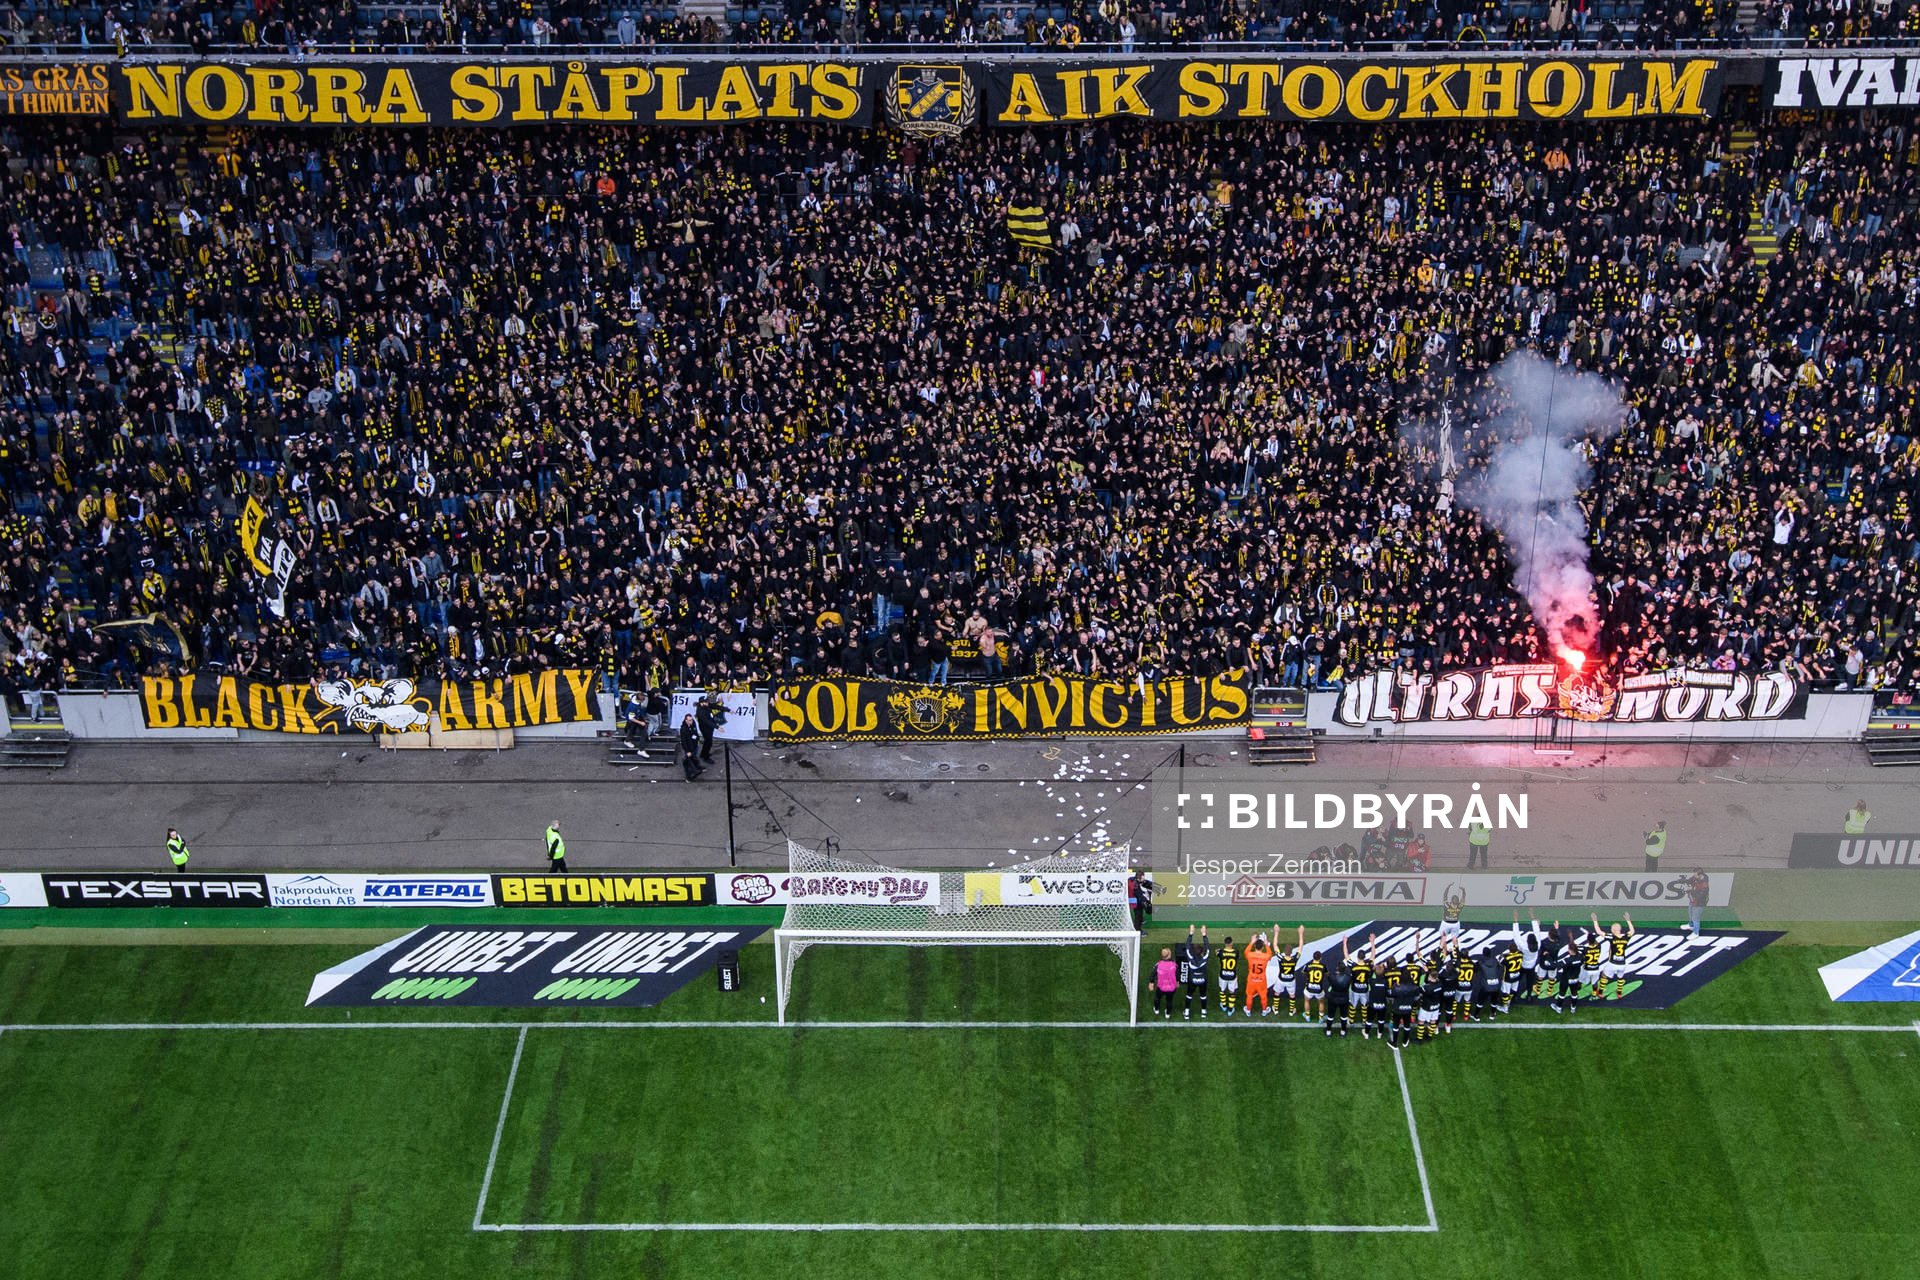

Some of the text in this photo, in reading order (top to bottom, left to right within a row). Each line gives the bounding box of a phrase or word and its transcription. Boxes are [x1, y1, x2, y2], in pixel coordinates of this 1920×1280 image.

[33, 64, 109, 91] GRÄS
[122, 61, 864, 124] NORRA STÅPLATS
[998, 60, 1719, 123] AIK STOCKHOLM
[22, 92, 110, 114] HIMLEN
[951, 649, 979, 658] 1937
[142, 669, 594, 734] BLACK ARMY
[671, 695, 689, 706] 451
[771, 667, 1249, 737] SOL INVICTUS
[1339, 668, 1797, 727] ULTRAS NORD
[735, 706, 755, 717] 474
[50, 881, 265, 899] TEXSTAR
[272, 885, 354, 897] Takprodukter
[364, 884, 486, 897] KATEPAL
[500, 877, 707, 903] BETONMAST
[1041, 874, 1124, 894] webe
[1269, 880, 1416, 900] BYGMA
[1544, 880, 1689, 901] TEKNOS
[275, 896, 357, 906] Norden AB
[388, 931, 740, 974] UNIBET UNIBET
[1616, 944, 1625, 956] 3
[1221, 958, 1236, 970] 10
[1585, 953, 1600, 965] 25
[1251, 963, 1264, 974] 15
[1283, 966, 1292, 974] 7
[1458, 969, 1474, 981] 20
[722, 968, 732, 990] SELECT
[1308, 970, 1323, 983] 19
[1356, 972, 1366, 983] 4
